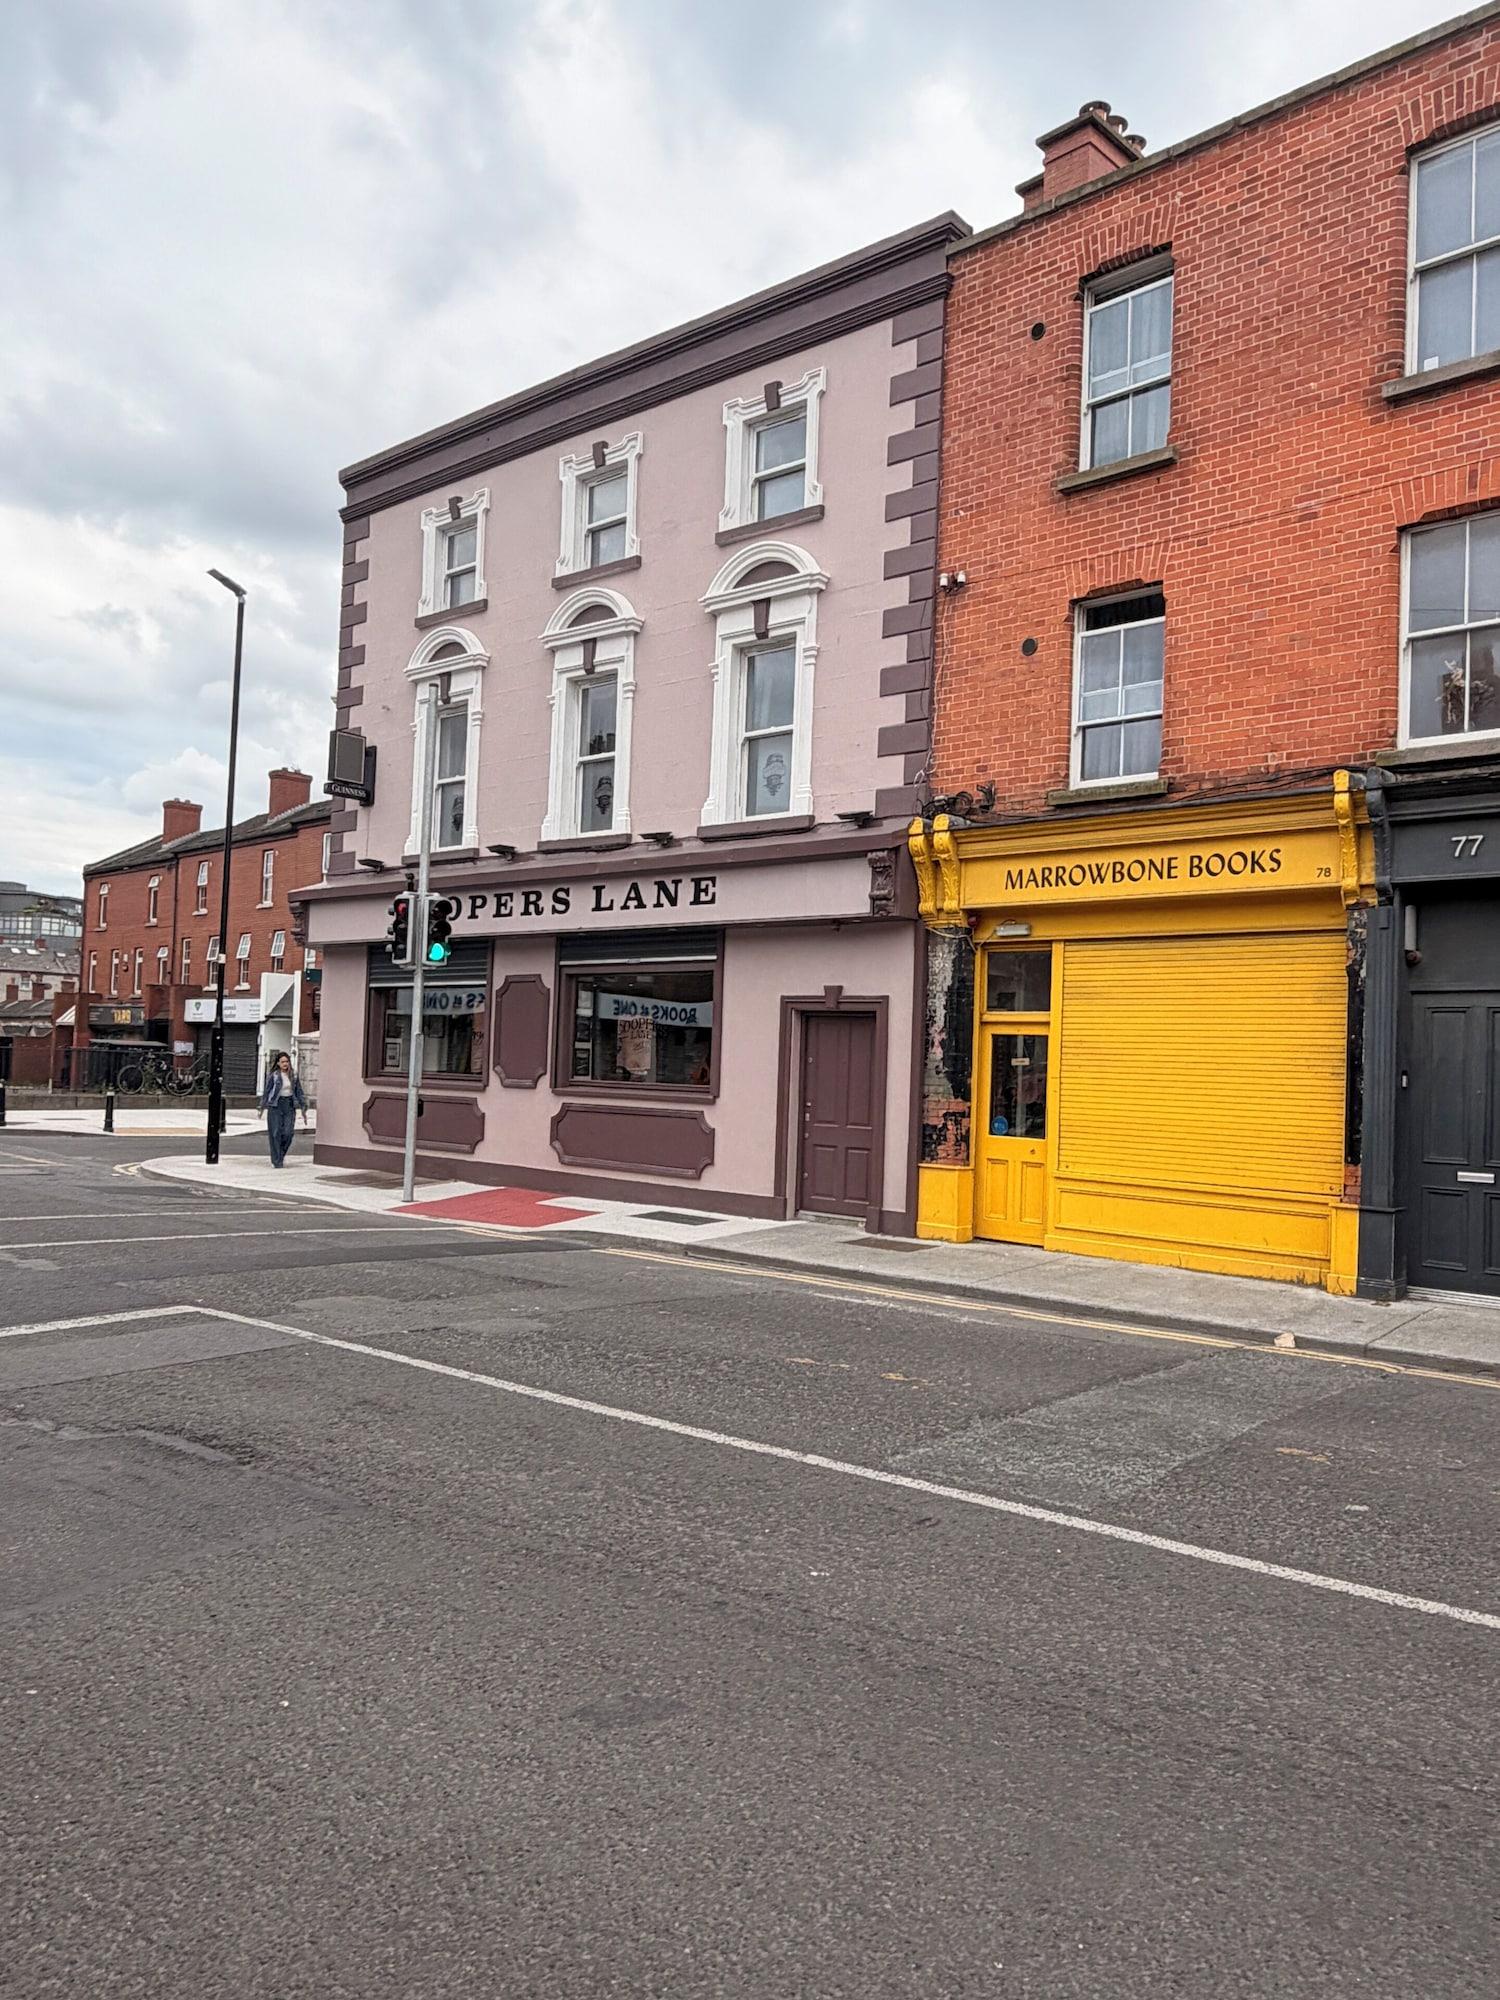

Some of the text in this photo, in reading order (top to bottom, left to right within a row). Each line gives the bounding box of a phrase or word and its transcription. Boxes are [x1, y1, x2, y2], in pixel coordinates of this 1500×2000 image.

[332, 783, 366, 798] GUINNESS
[1451, 834, 1484, 857] 77
[1004, 848, 1282, 890] MARROWBONE BOOKS
[1316, 867, 1332, 878] 78
[448, 876, 717, 921] OPERS LANE
